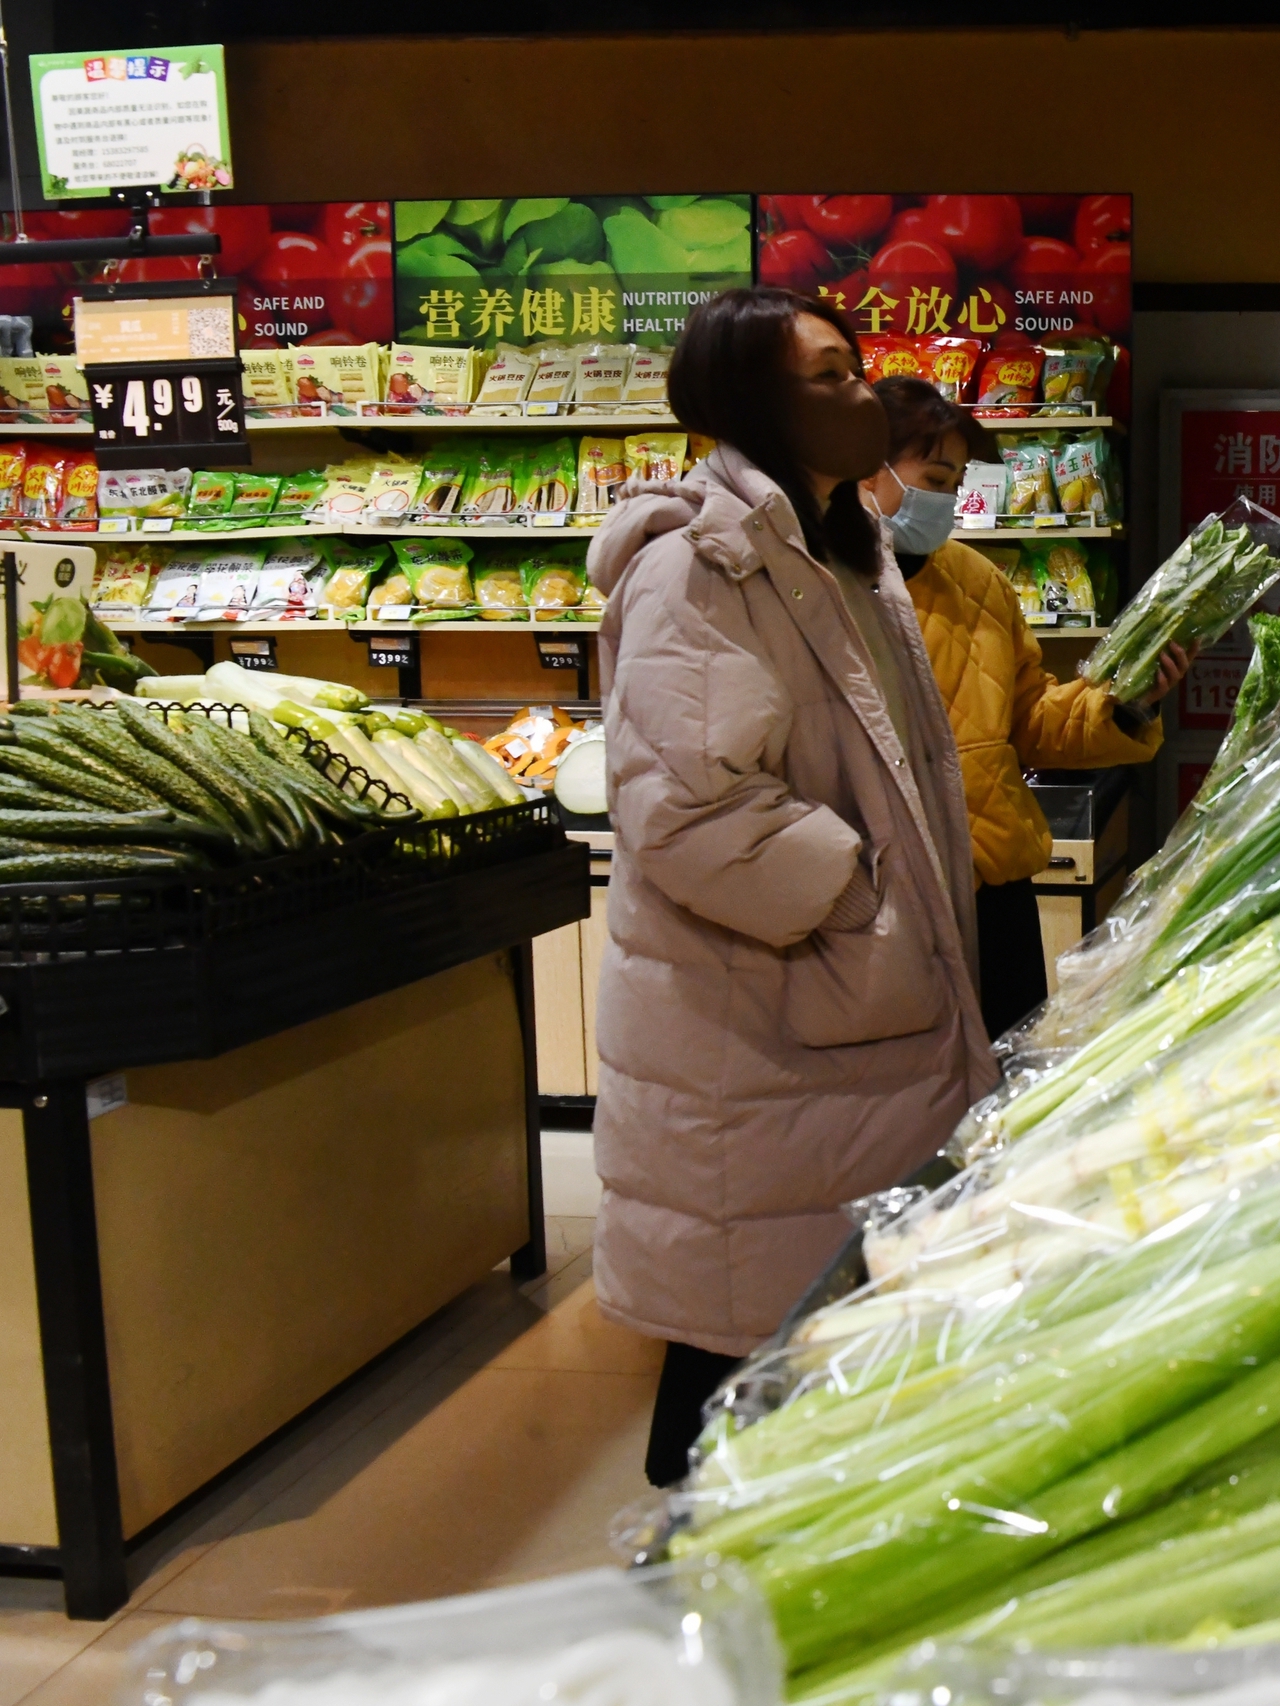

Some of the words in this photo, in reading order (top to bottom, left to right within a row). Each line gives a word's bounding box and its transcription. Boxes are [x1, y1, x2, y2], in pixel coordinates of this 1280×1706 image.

[84, 56, 170, 82] 温馨提示
[253, 297, 289, 311] SAFE
[293, 296, 325, 310] AND
[1014, 290, 1055, 305] SAFE
[1058, 290, 1095, 305] AND
[418, 286, 617, 338] 营养健康
[254, 322, 309, 337] SOUND
[1014, 317, 1074, 331] SOUND
[330, 356, 367, 368] 响铃卷
